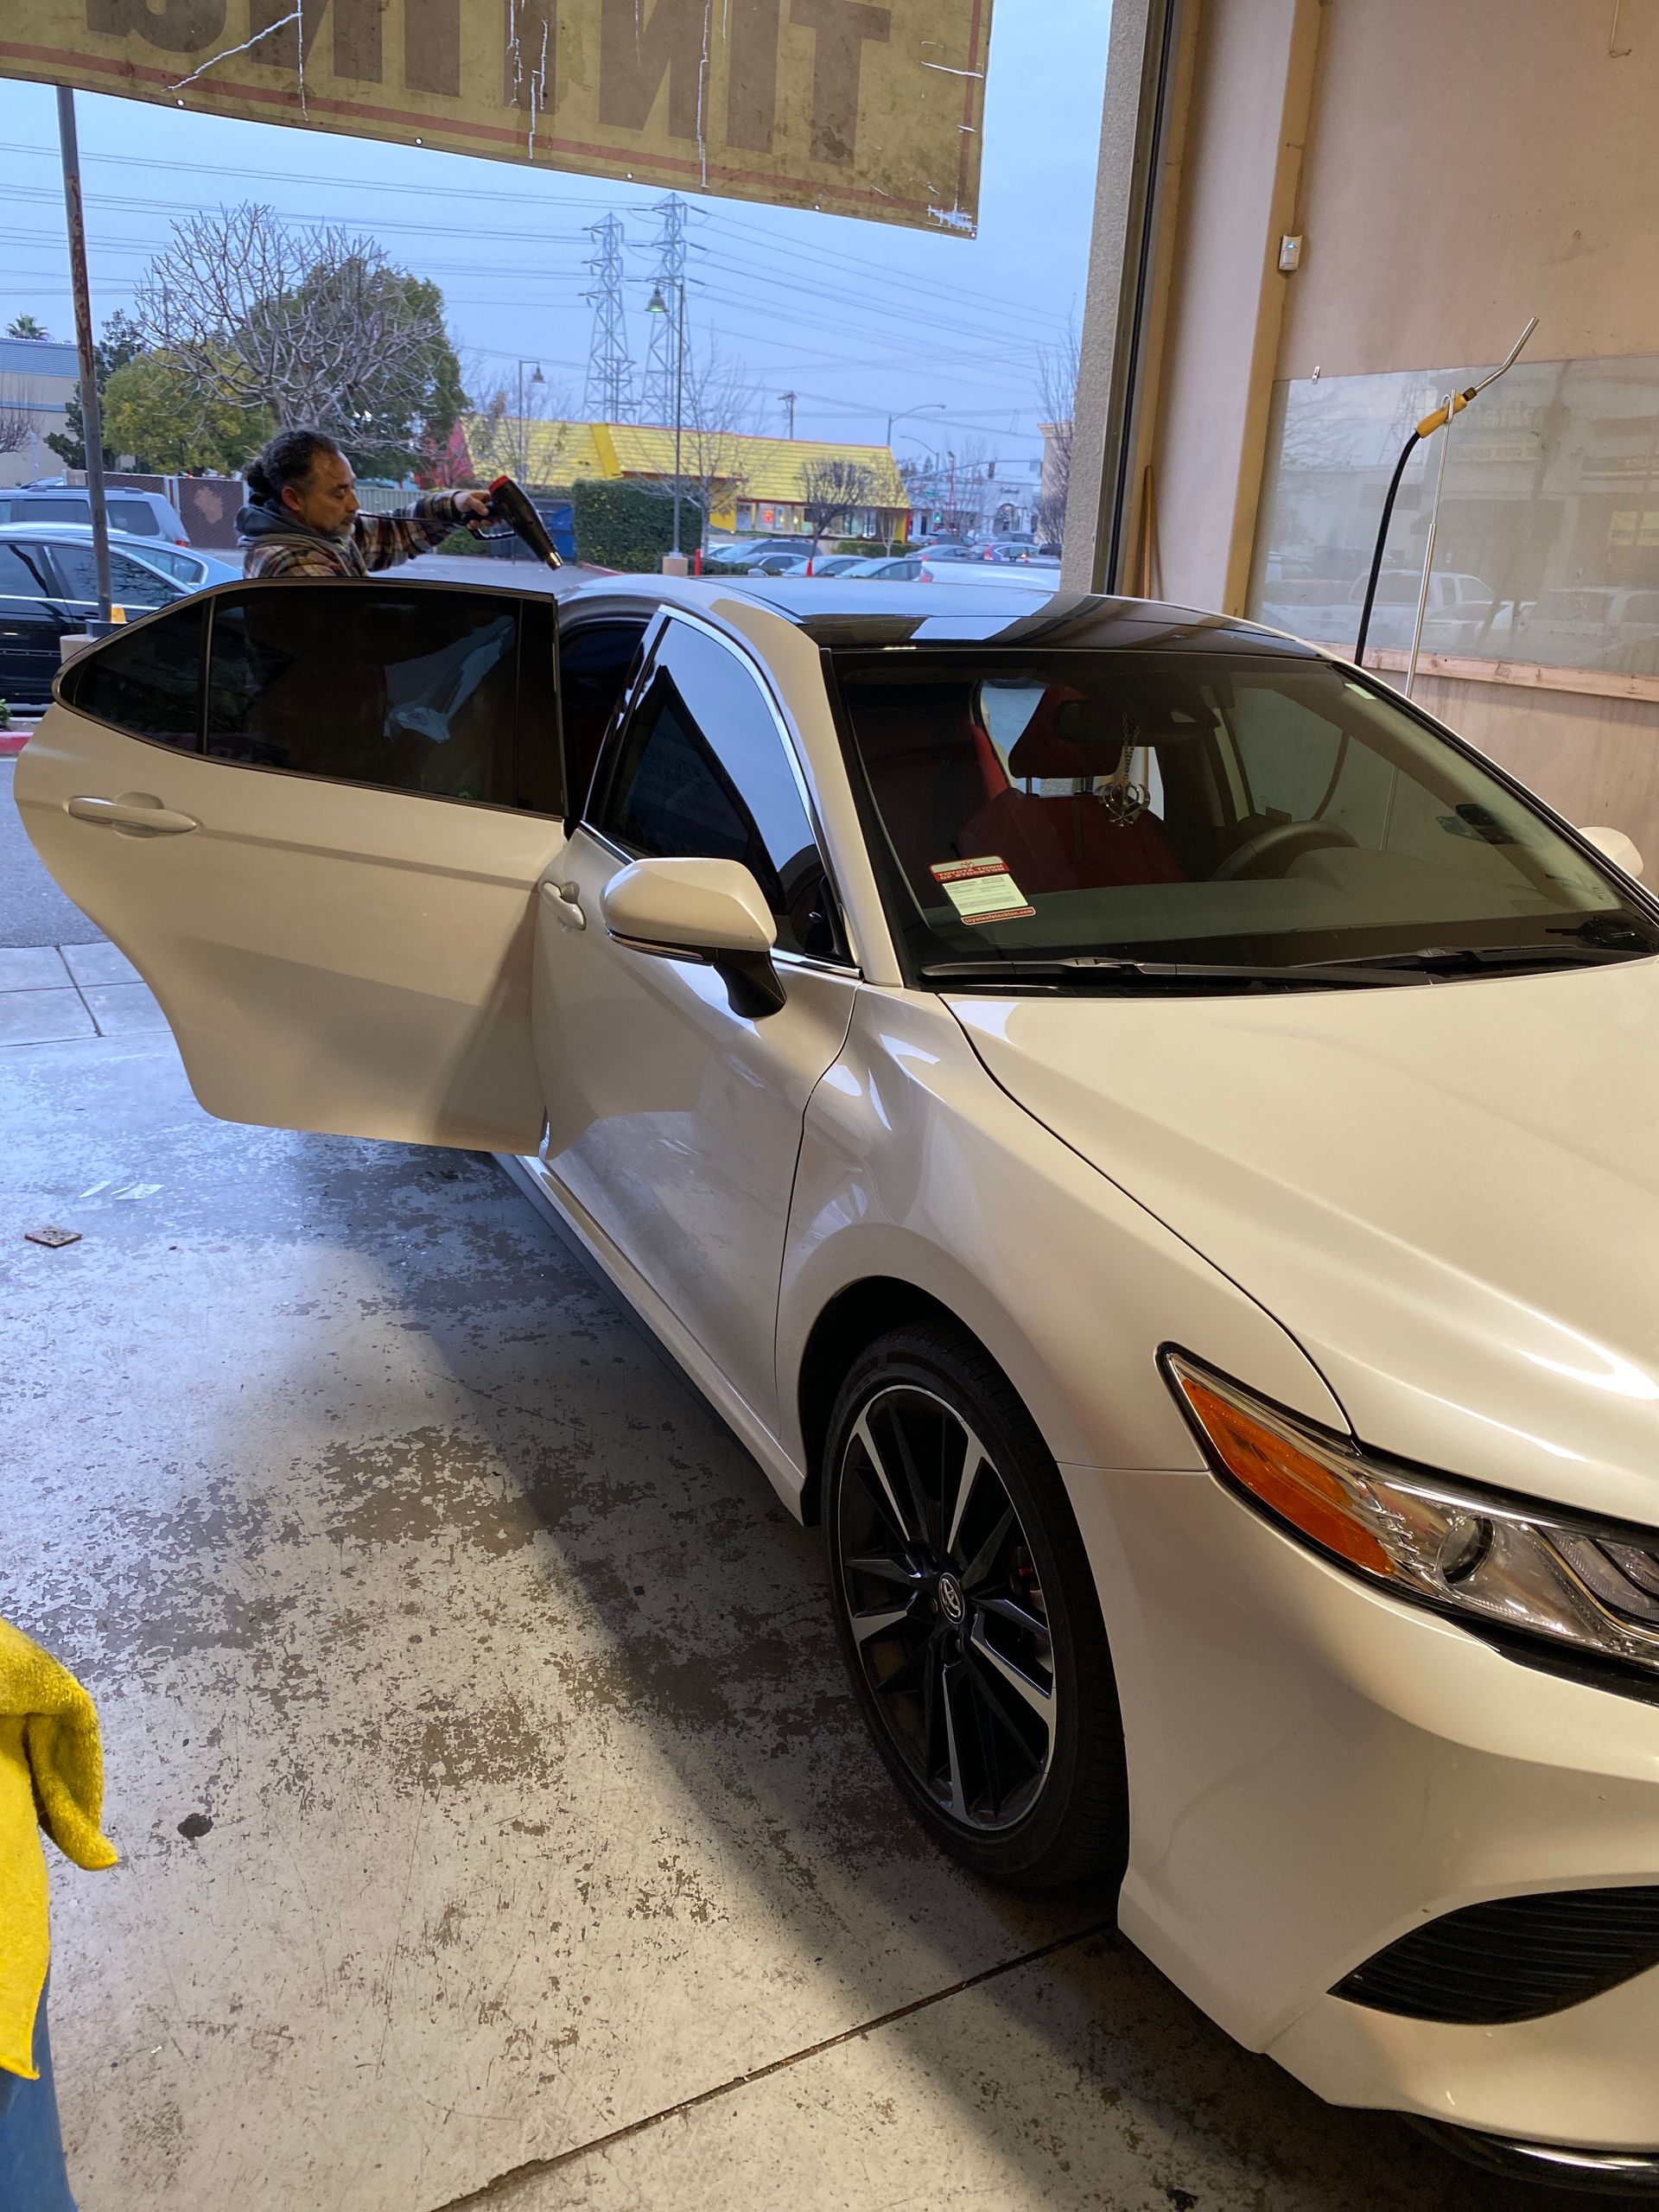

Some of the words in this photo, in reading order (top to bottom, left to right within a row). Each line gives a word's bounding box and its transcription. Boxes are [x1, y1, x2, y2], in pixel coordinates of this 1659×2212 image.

[938, 868, 976, 877] TOYOTA
[954, 867, 1005, 879] STOCKTON
[964, 910, 1033, 924] toyotaofstockton.com
